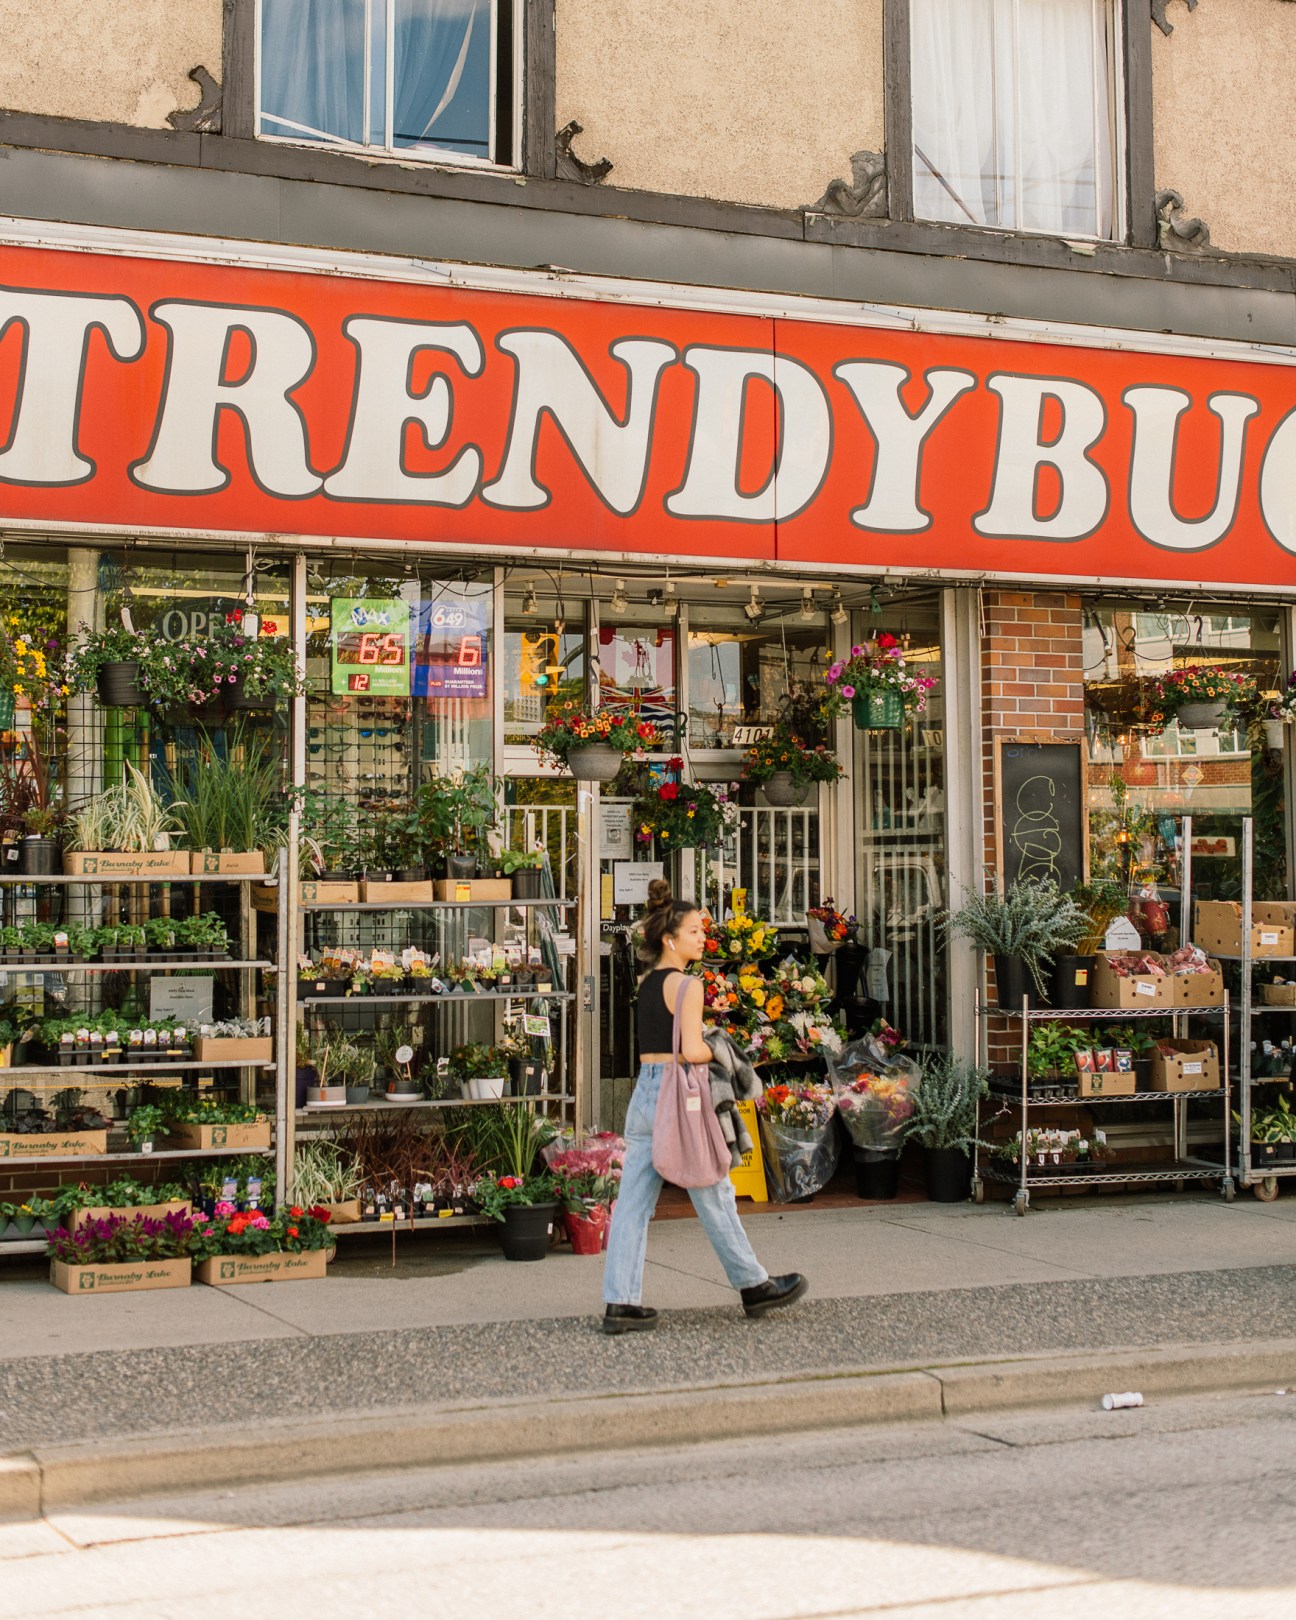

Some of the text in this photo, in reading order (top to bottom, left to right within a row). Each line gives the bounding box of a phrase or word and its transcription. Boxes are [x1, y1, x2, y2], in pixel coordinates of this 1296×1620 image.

[163, 610, 228, 643] OPE
[359, 633, 402, 664] 65
[458, 636, 479, 666] 6
[354, 674, 368, 690] 12
[734, 728, 771, 743] 4101
[99, 859, 170, 869] Burnaby Lake
[12, 1140, 86, 1150] Burnaby Lake
[237, 1259, 308, 1270] Burnaby Lake
[97, 1270, 171, 1281] Burnaby Lake
